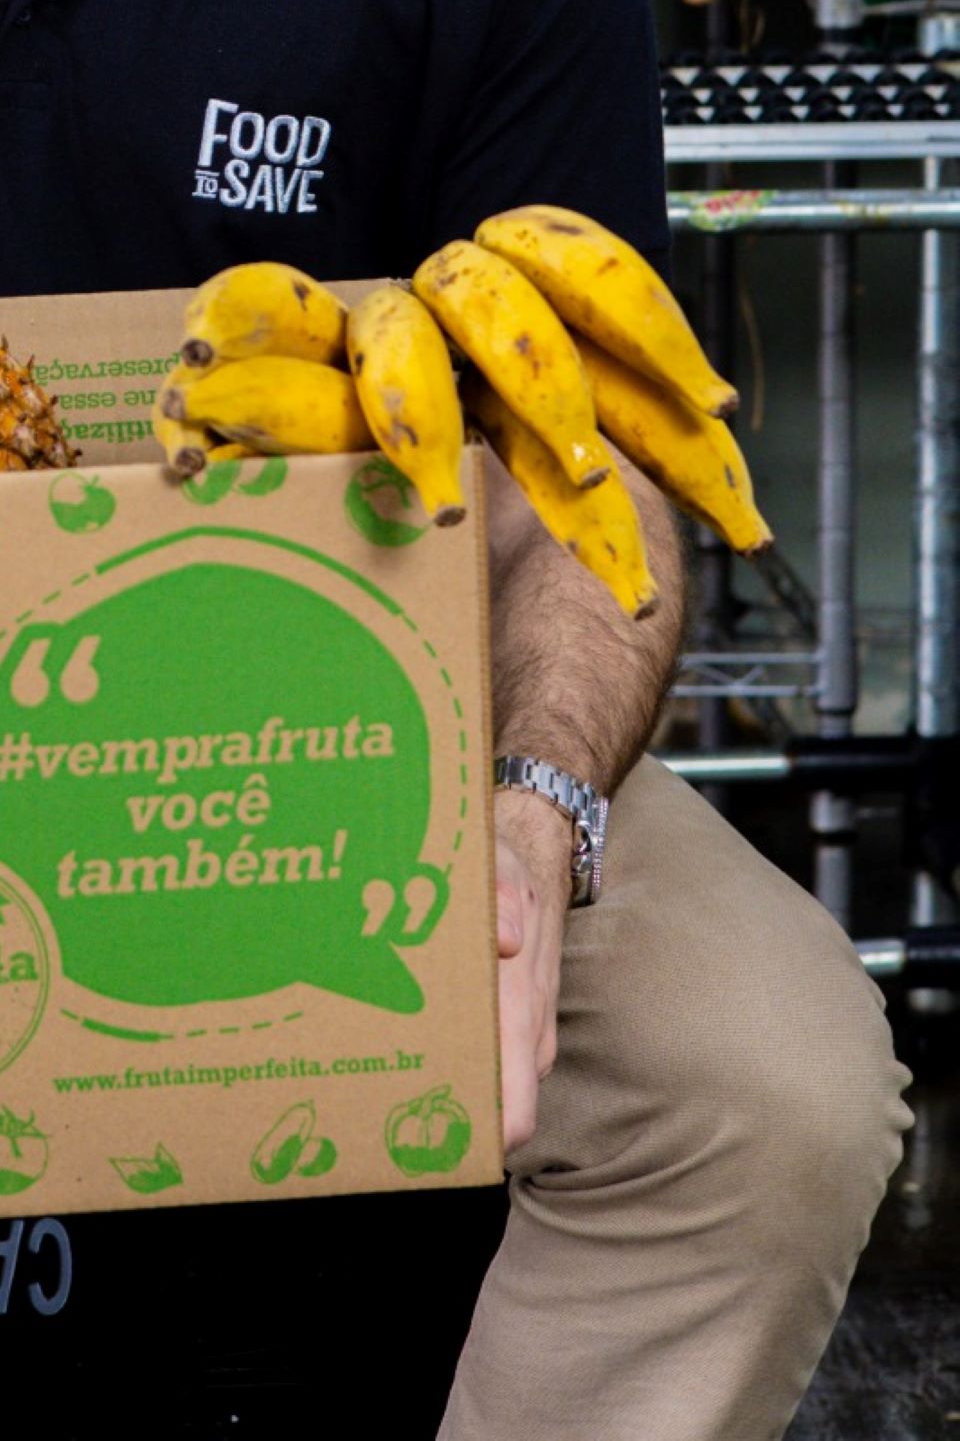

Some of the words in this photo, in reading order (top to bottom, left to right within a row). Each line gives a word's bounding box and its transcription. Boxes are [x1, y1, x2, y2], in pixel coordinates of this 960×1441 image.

[197, 98, 331, 168] FOOD
[219, 159, 325, 214] SAVE
[126, 773, 271, 833] você
[55, 829, 348, 898] também!
[52, 1049, 425, 1094] www.frutaimperfeita.com.br
